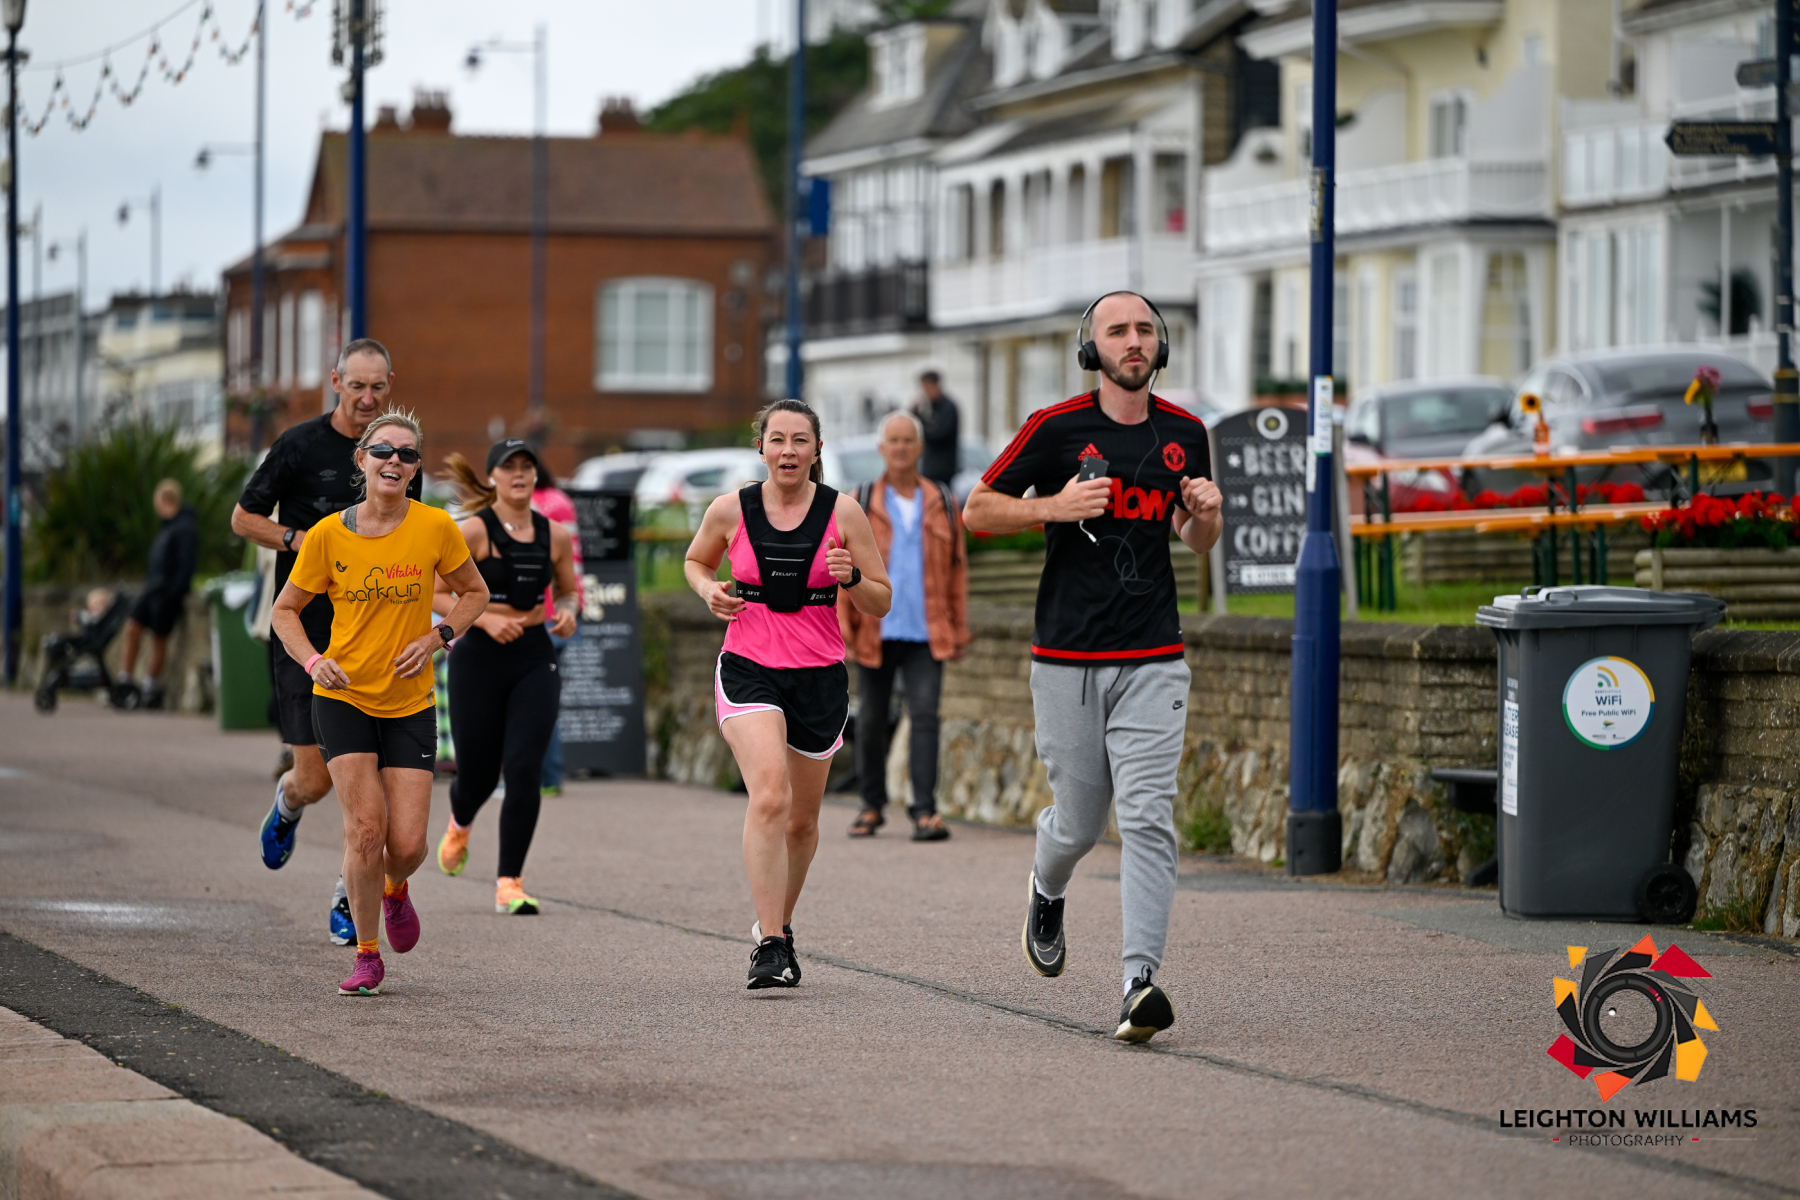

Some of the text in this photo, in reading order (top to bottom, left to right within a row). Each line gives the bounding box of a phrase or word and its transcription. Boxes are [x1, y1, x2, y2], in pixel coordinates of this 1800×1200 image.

[1243, 443, 1306, 476] BEER
[1252, 484, 1305, 515] GIN
[1234, 523, 1306, 557] COFF
[386, 563, 422, 581] Vitality
[346, 578, 421, 604] parkrun
[1595, 695, 1622, 706] WiFi
[1598, 709, 1620, 717] Public
